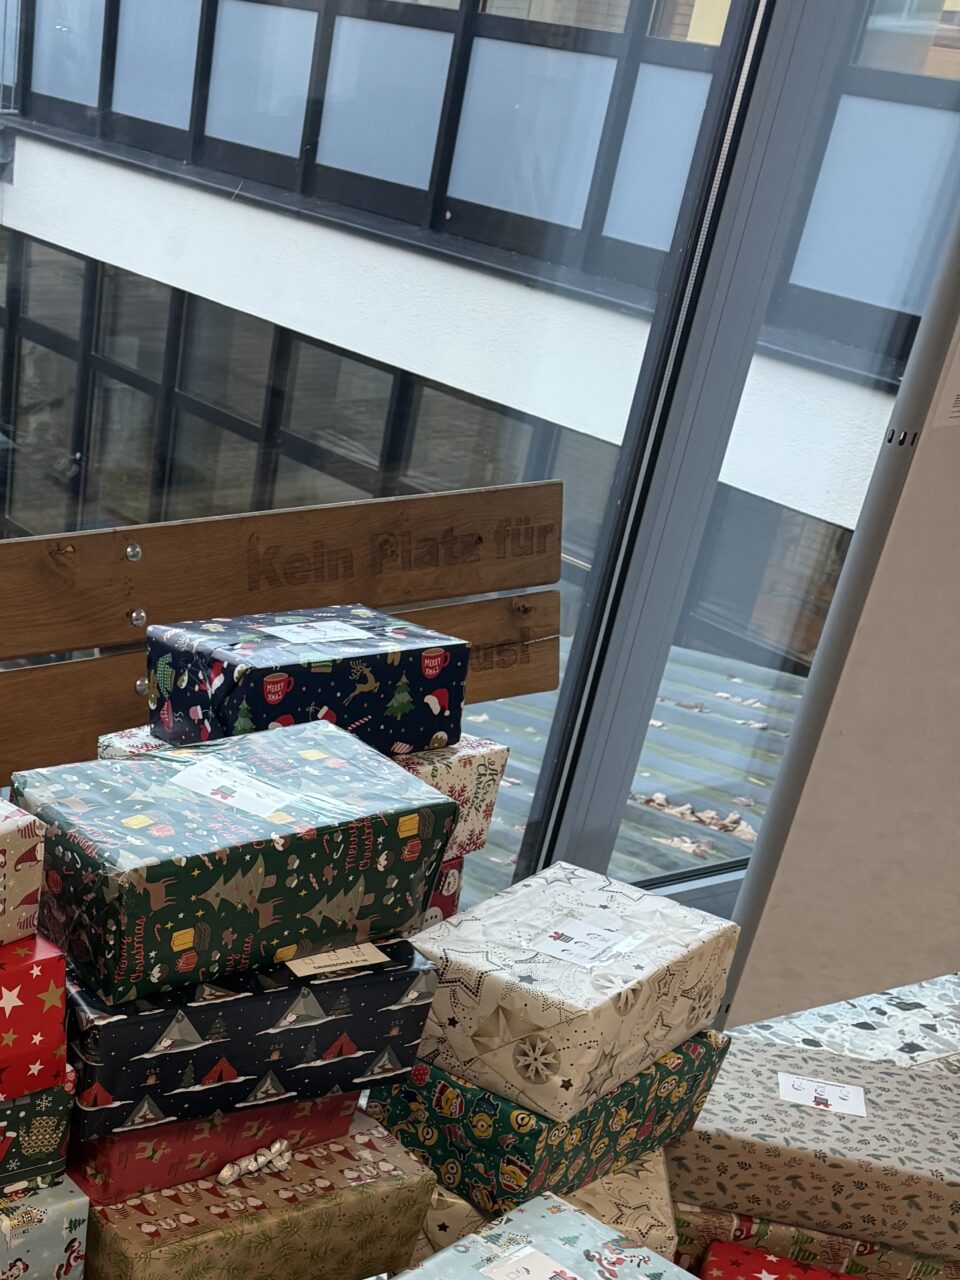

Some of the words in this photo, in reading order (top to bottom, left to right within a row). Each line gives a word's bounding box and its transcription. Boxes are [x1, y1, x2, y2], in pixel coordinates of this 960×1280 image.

[247, 538, 354, 592] Kein
[370, 526, 482, 574] Platz
[494, 517, 554, 560] für
[425, 656, 441, 667] MERRY
[425, 666, 440, 675] XMAS
[266, 682, 284, 693] MERRY
[267, 691, 283, 701] XMAS
